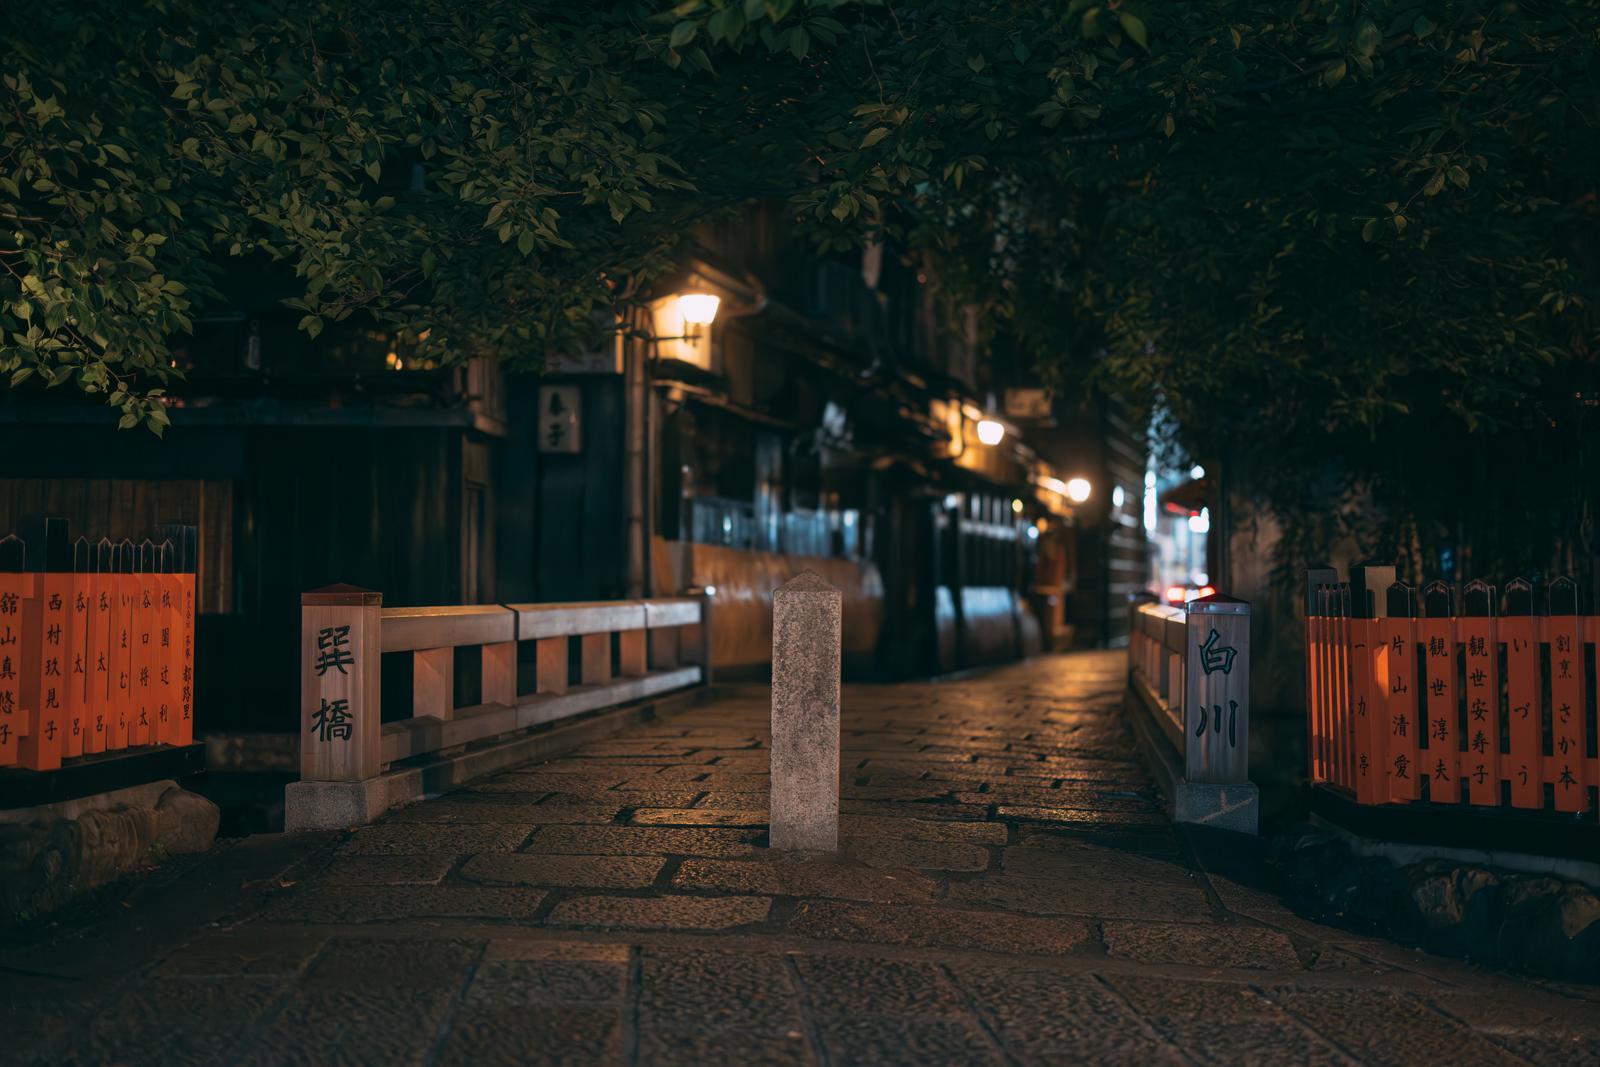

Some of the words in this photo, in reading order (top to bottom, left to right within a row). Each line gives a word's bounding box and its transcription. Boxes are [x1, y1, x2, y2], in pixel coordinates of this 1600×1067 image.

[311, 625, 354, 742] 巽橋
[1196, 629, 1238, 748] 白川
[1354, 643, 1369, 777] 一力亭
[1391, 634, 1411, 780] 片山清愛
[1428, 635, 1450, 782] 観世淳夫
[1468, 635, 1489, 785] 観世安寿子
[1513, 638, 1530, 786] いづう
